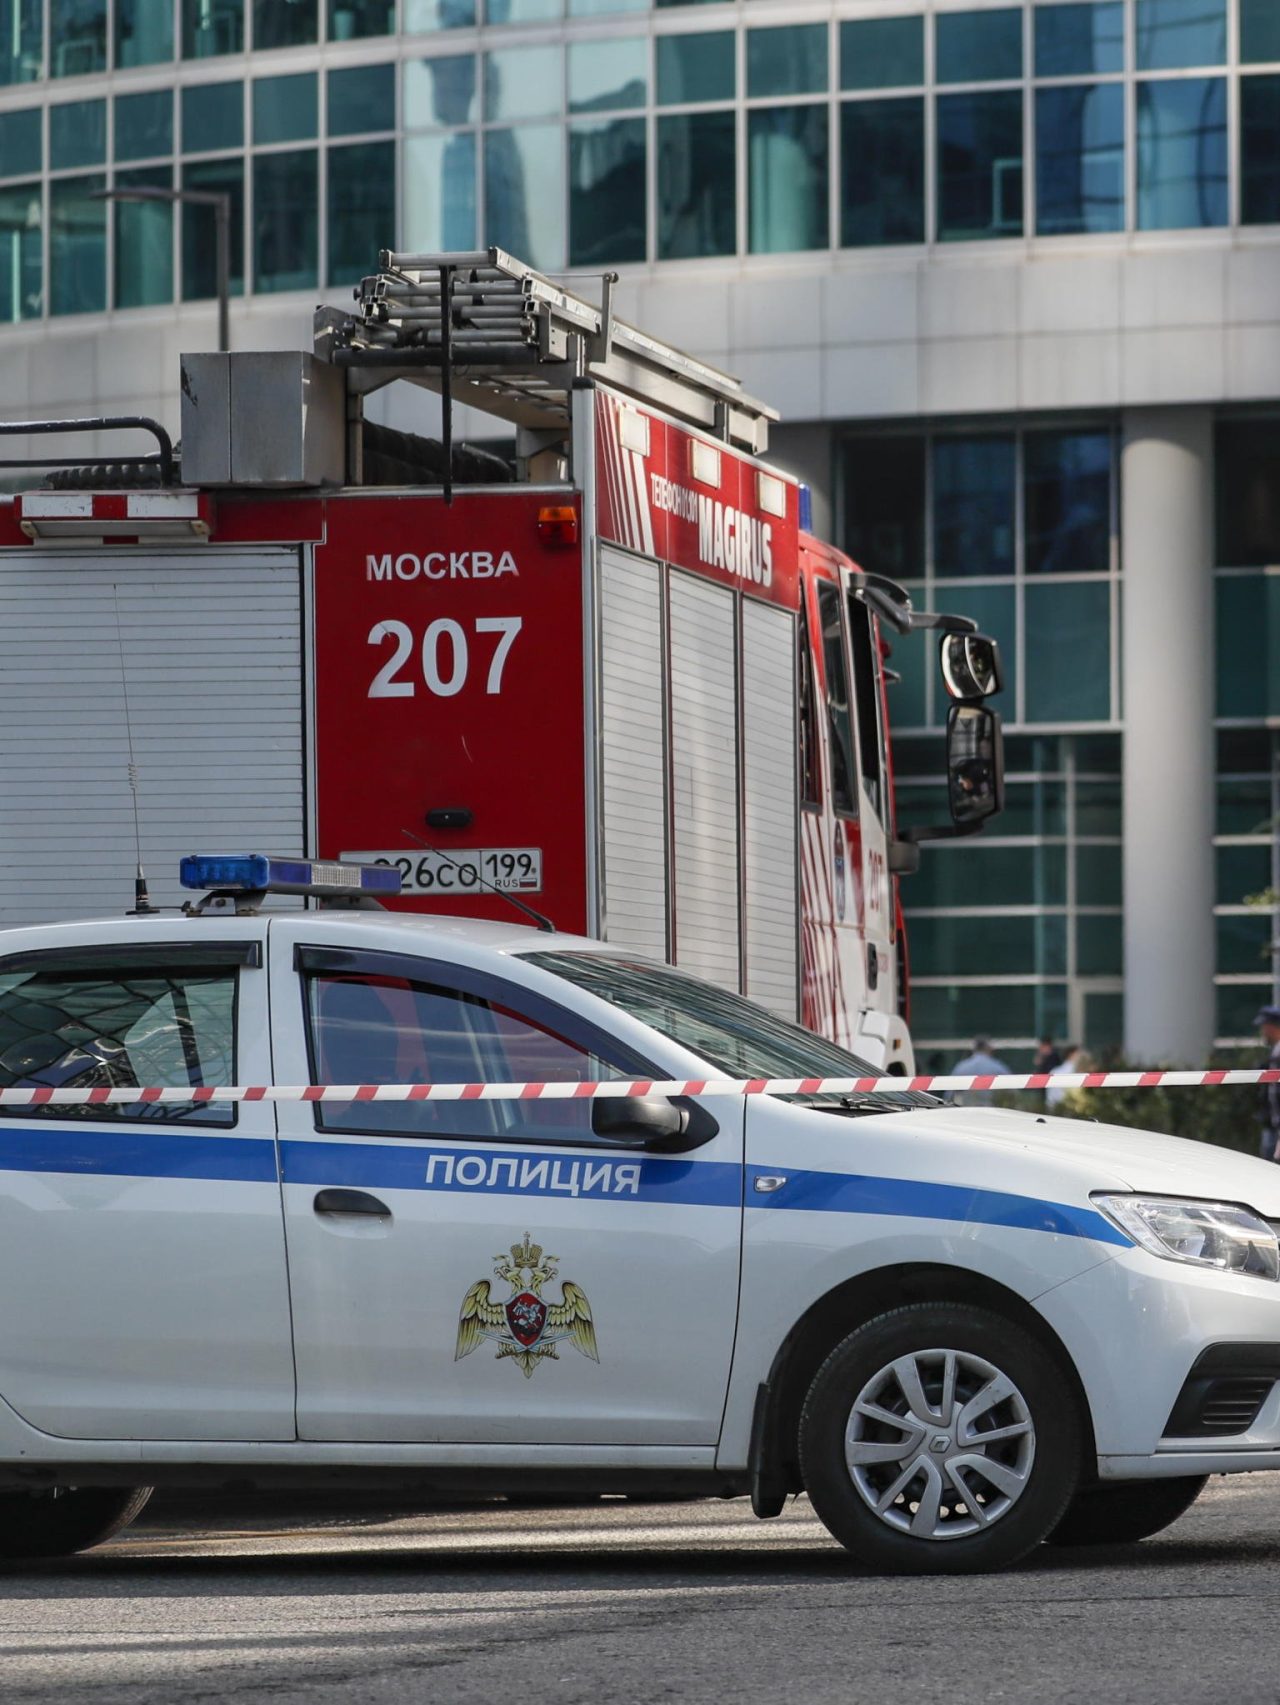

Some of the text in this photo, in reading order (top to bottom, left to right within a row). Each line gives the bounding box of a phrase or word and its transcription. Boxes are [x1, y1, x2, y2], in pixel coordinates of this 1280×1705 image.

[699, 494, 772, 588] MAGIRUS
[366, 551, 520, 581] МОСКВА
[367, 616, 523, 698] 207
[374, 853, 532, 888] 26СО 199
[495, 879, 519, 888] RUS
[425, 1154, 642, 1197] ПОЛИЦИЯ
